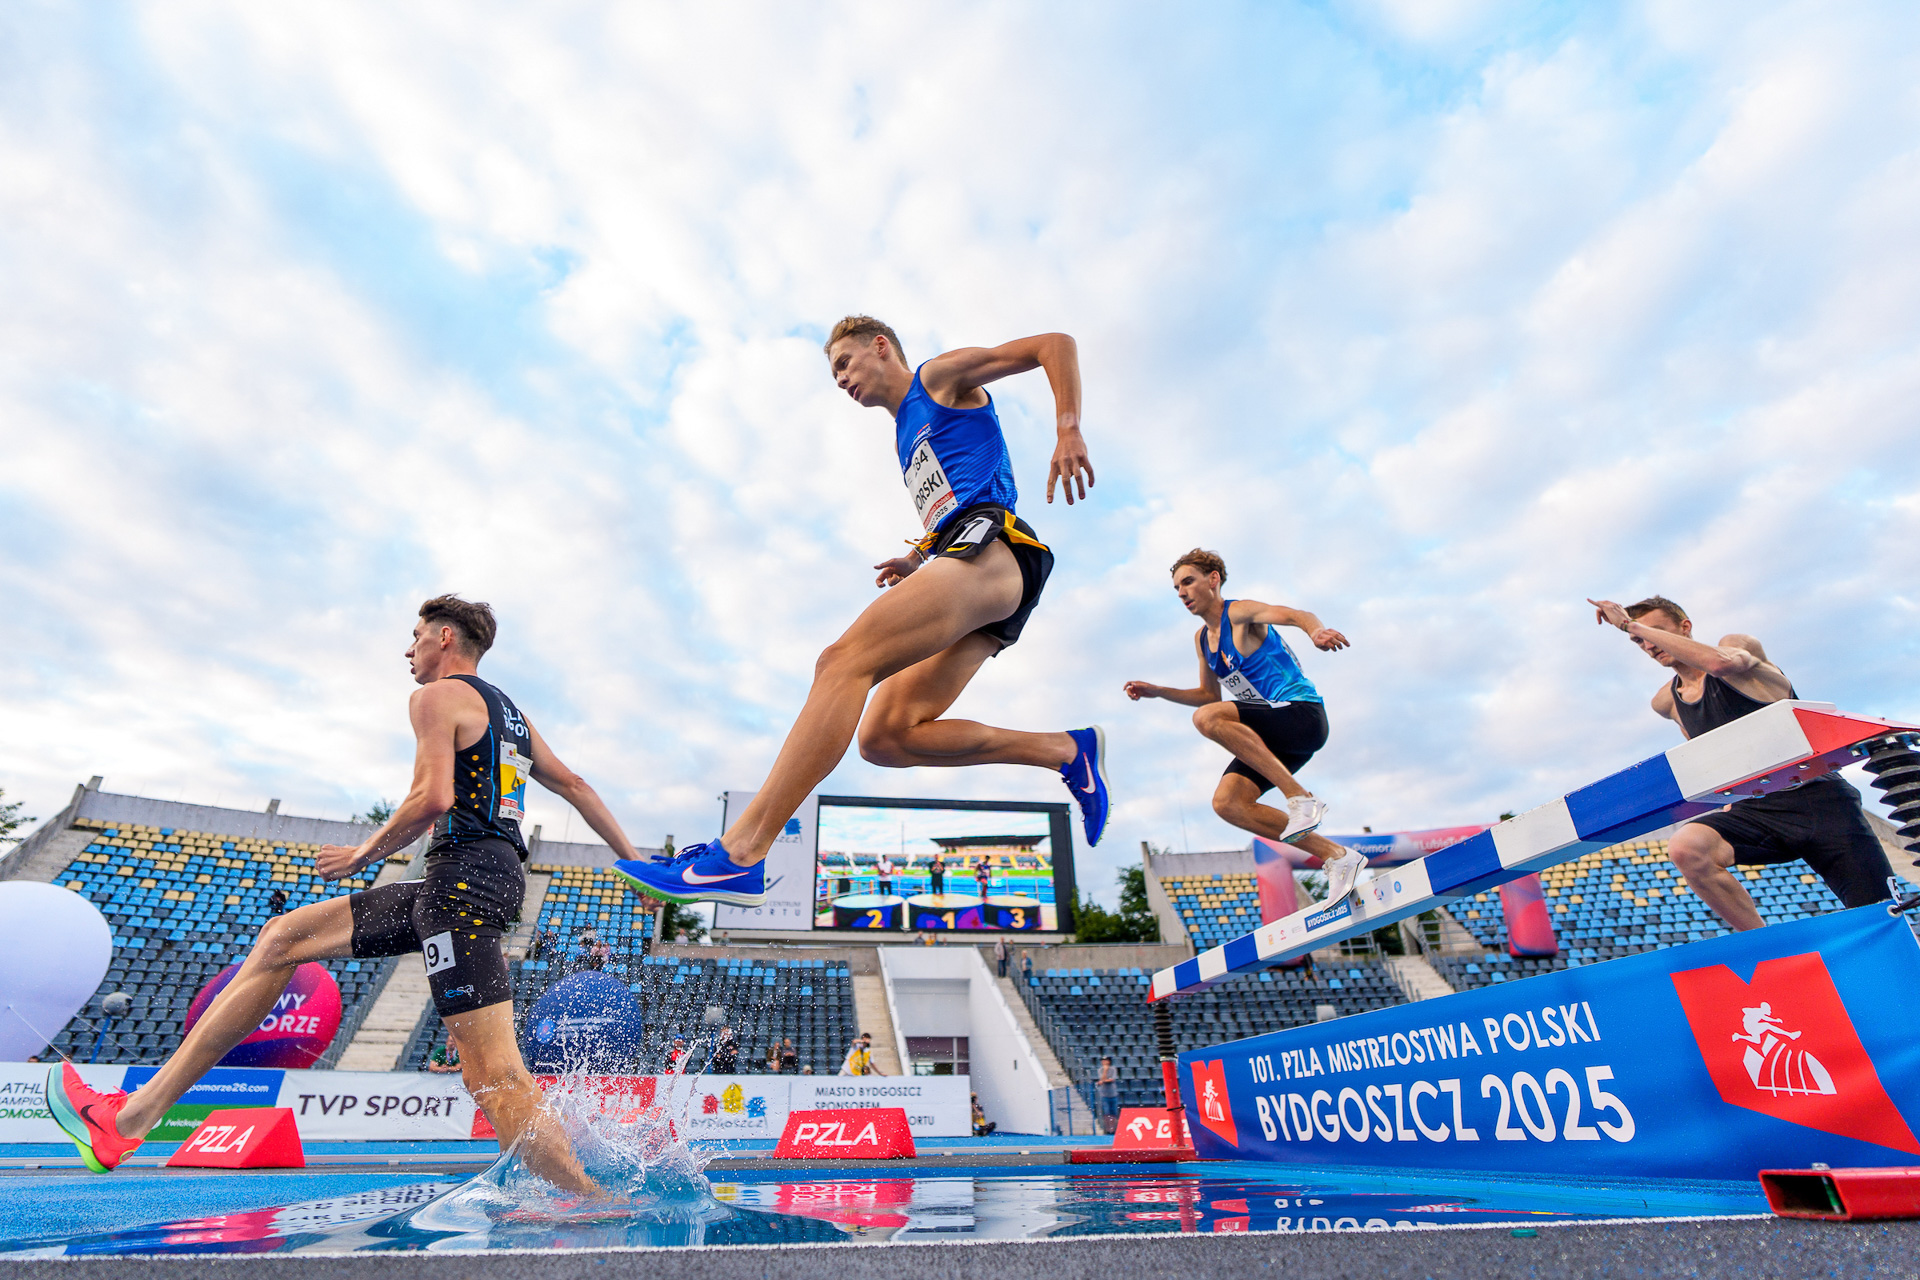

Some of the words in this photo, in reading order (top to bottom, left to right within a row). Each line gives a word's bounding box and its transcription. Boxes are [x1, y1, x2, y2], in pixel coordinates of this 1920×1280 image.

[914, 470, 945, 516] ORSKI
[866, 909, 883, 929] 2
[941, 911, 955, 929] 1
[1010, 908, 1026, 929] 3
[259, 1013, 320, 1035] ORZE
[1248, 1054, 1281, 1084] 101.
[1281, 1047, 1325, 1080] PZLA
[1326, 1022, 1483, 1074] MISTRZOSTWA
[1483, 1001, 1602, 1054] POLSKI
[815, 1086, 856, 1097] MIASTO
[858, 1086, 922, 1097] BYDGOSZCZ
[299, 1094, 358, 1116] TVP
[364, 1095, 459, 1117] SPORT
[815, 1101, 881, 1110] SPONSOREM
[1255, 1078, 1481, 1143] BYDGOSZCZ
[1480, 1065, 1636, 1143] 2025
[185, 1125, 256, 1154] PZLA
[793, 1122, 879, 1147] PZLA
